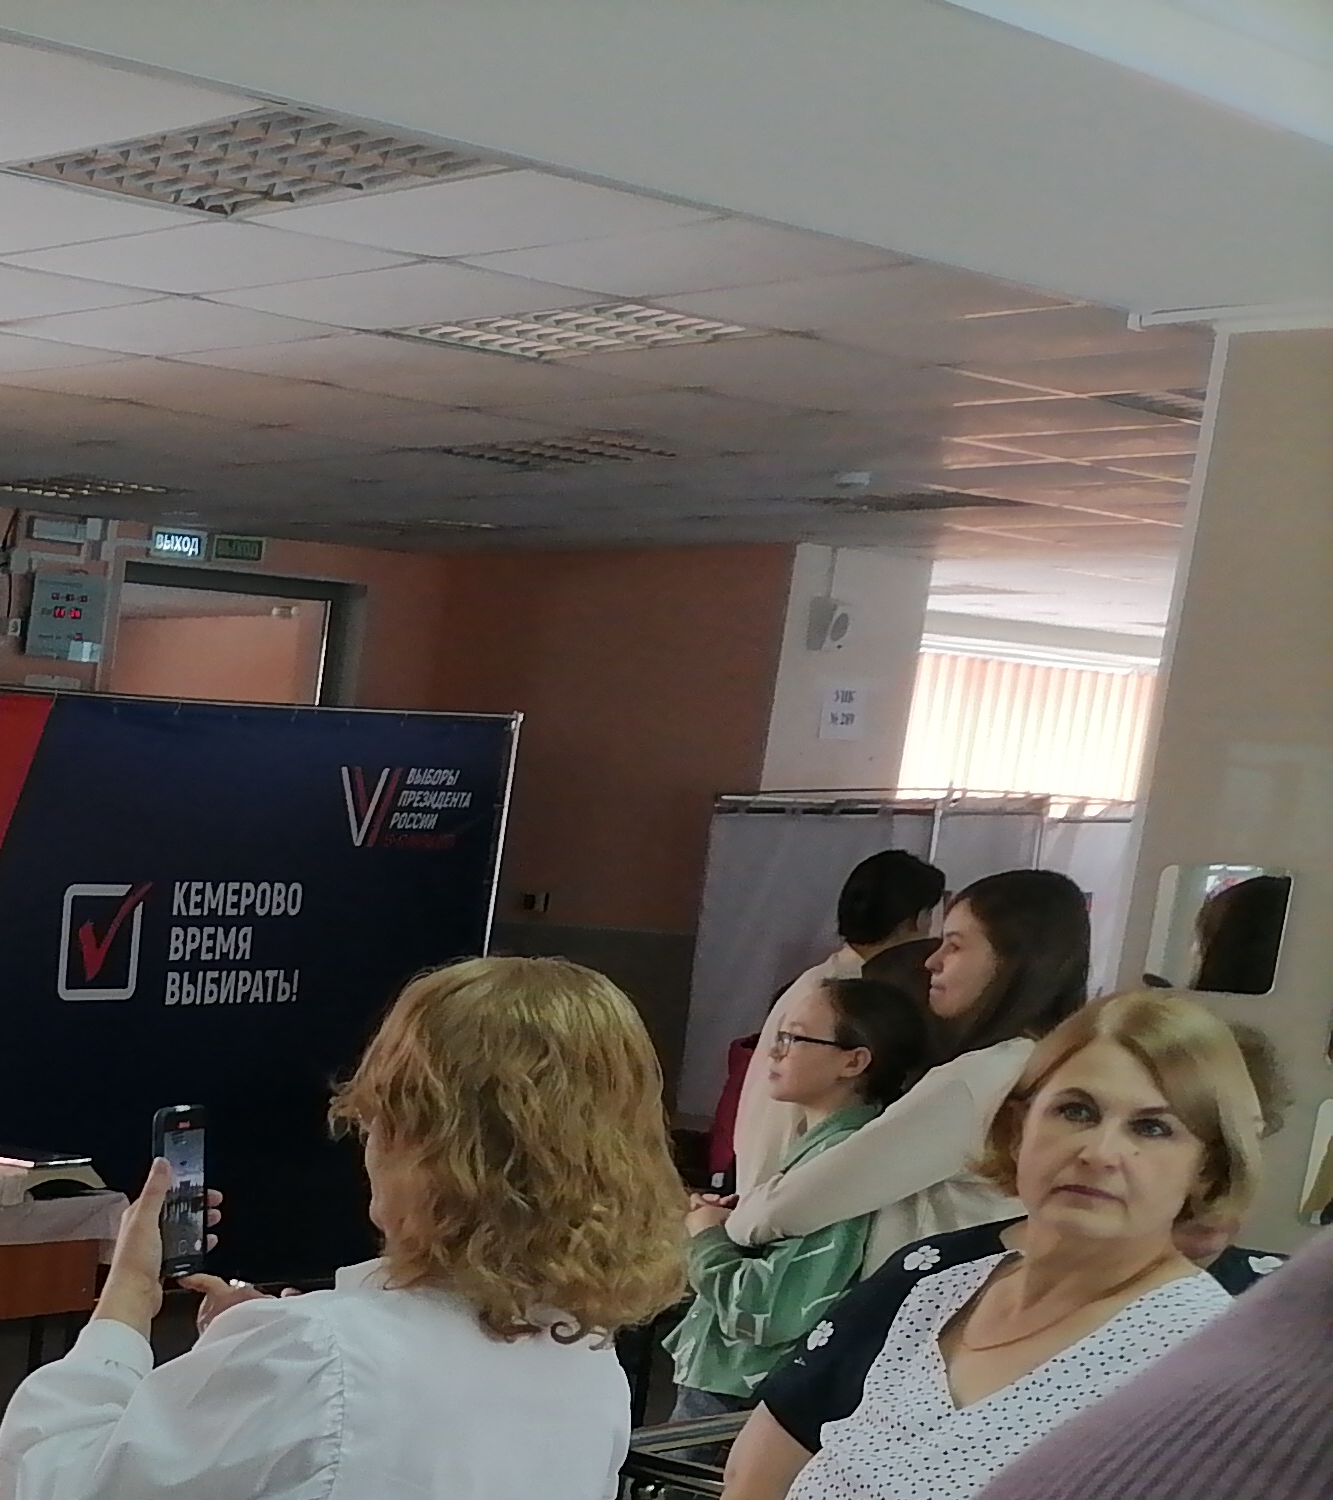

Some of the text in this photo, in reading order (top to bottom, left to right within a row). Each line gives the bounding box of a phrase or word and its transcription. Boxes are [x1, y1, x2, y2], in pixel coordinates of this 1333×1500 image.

[156, 533, 199, 556] ВЫХОД
[406, 767, 461, 786] ВЫБОРЫ
[397, 790, 472, 809] ПРЕЗИДЕНТА
[389, 812, 438, 829] РОССИИ
[172, 881, 303, 917] КЕМЕРОВО
[168, 926, 253, 961] ВРЕМЯ
[165, 969, 299, 1005] ВЫБИРАТЬ!
